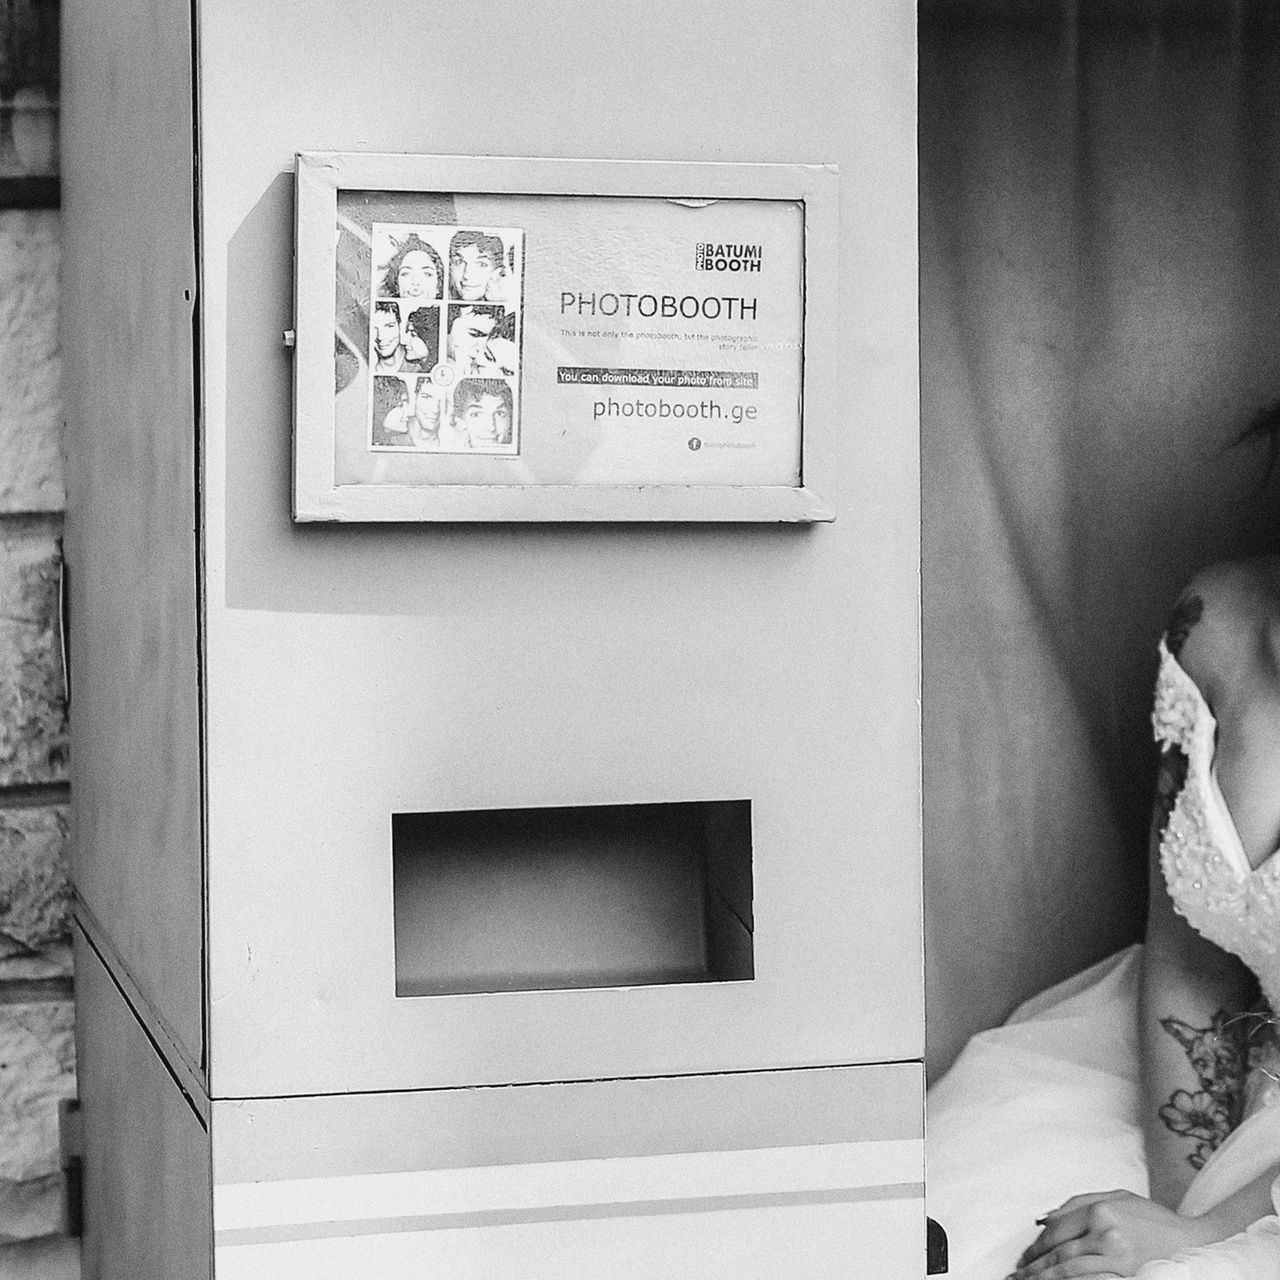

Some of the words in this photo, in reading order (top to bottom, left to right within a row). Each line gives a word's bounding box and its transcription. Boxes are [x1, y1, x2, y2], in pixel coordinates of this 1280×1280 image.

[706, 243, 762, 259] BATUMI
[705, 258, 761, 272] BOOTH
[560, 291, 757, 320] PHOTOBOOTH
[560, 329, 577, 337] This
[578, 329, 585, 337] is
[587, 330, 600, 338] not
[620, 331, 634, 339] the
[559, 371, 578, 381] You
[580, 373, 599, 382] can
[601, 373, 650, 384] download
[651, 375, 675, 385] your
[677, 375, 707, 386] photo
[708, 375, 732, 386] from
[734, 377, 754, 387] site
[593, 396, 757, 424] photobooth.ge
